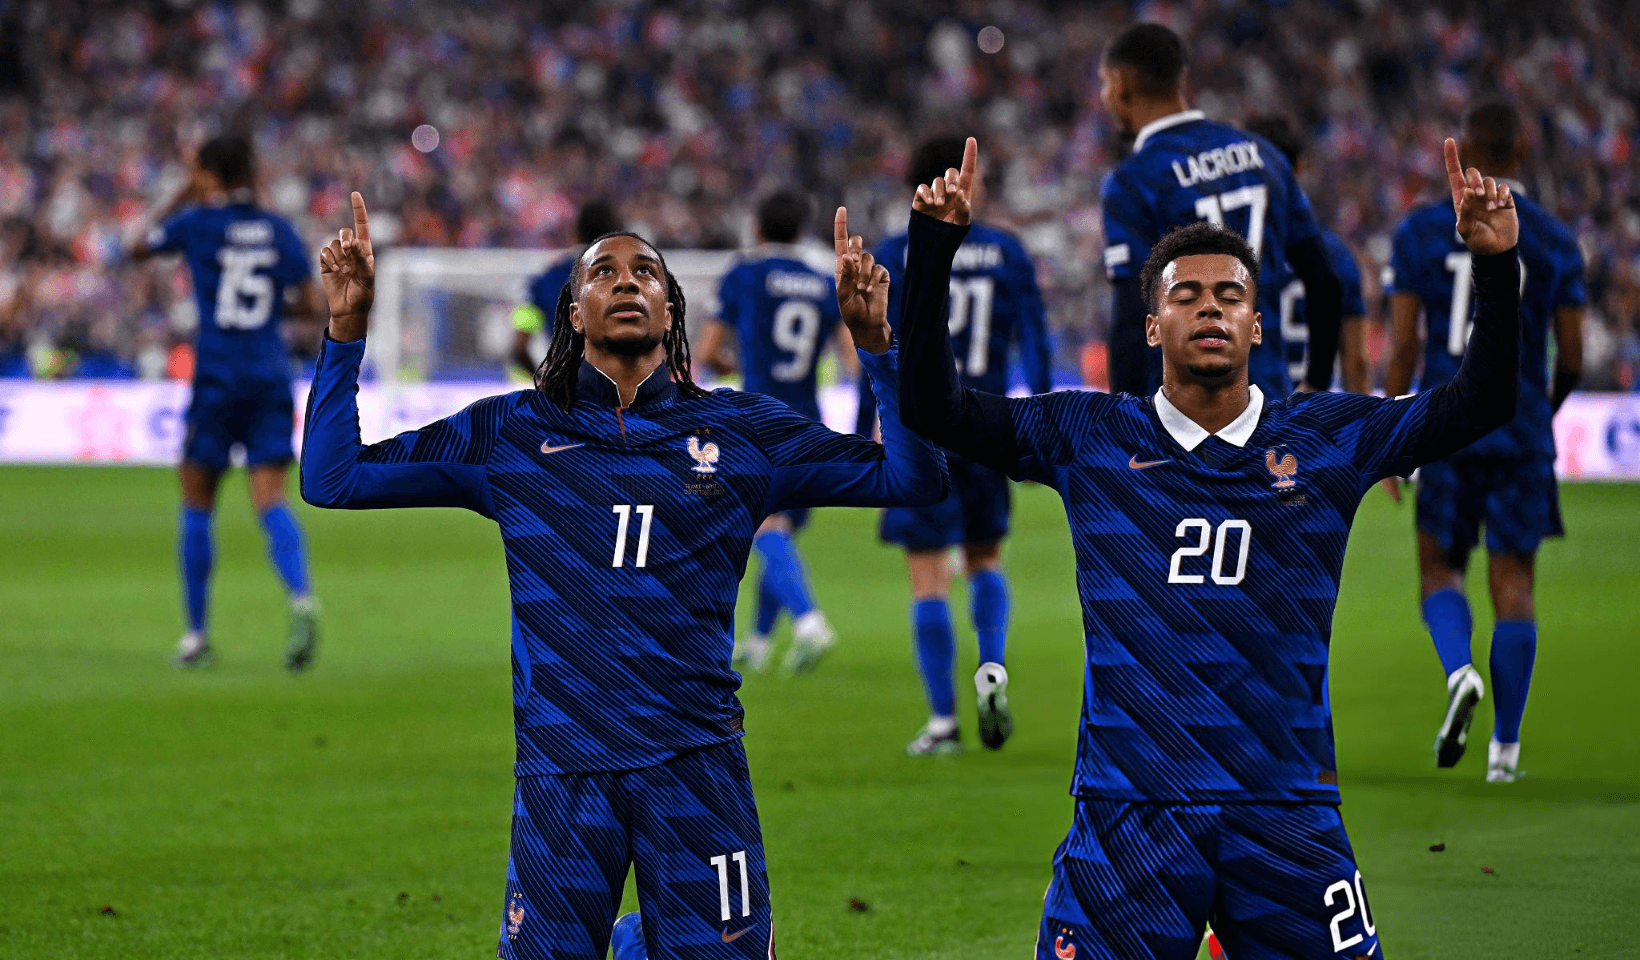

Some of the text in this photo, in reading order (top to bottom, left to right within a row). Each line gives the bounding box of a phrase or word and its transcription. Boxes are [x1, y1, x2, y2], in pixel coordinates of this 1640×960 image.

[1172, 141, 1264, 187] LACROIX
[1195, 184, 1268, 262] 17
[215, 246, 279, 330] 15
[771, 300, 821, 382] 9
[612, 505, 654, 567] 11
[1168, 518, 1251, 585] 20
[710, 851, 750, 921] 11
